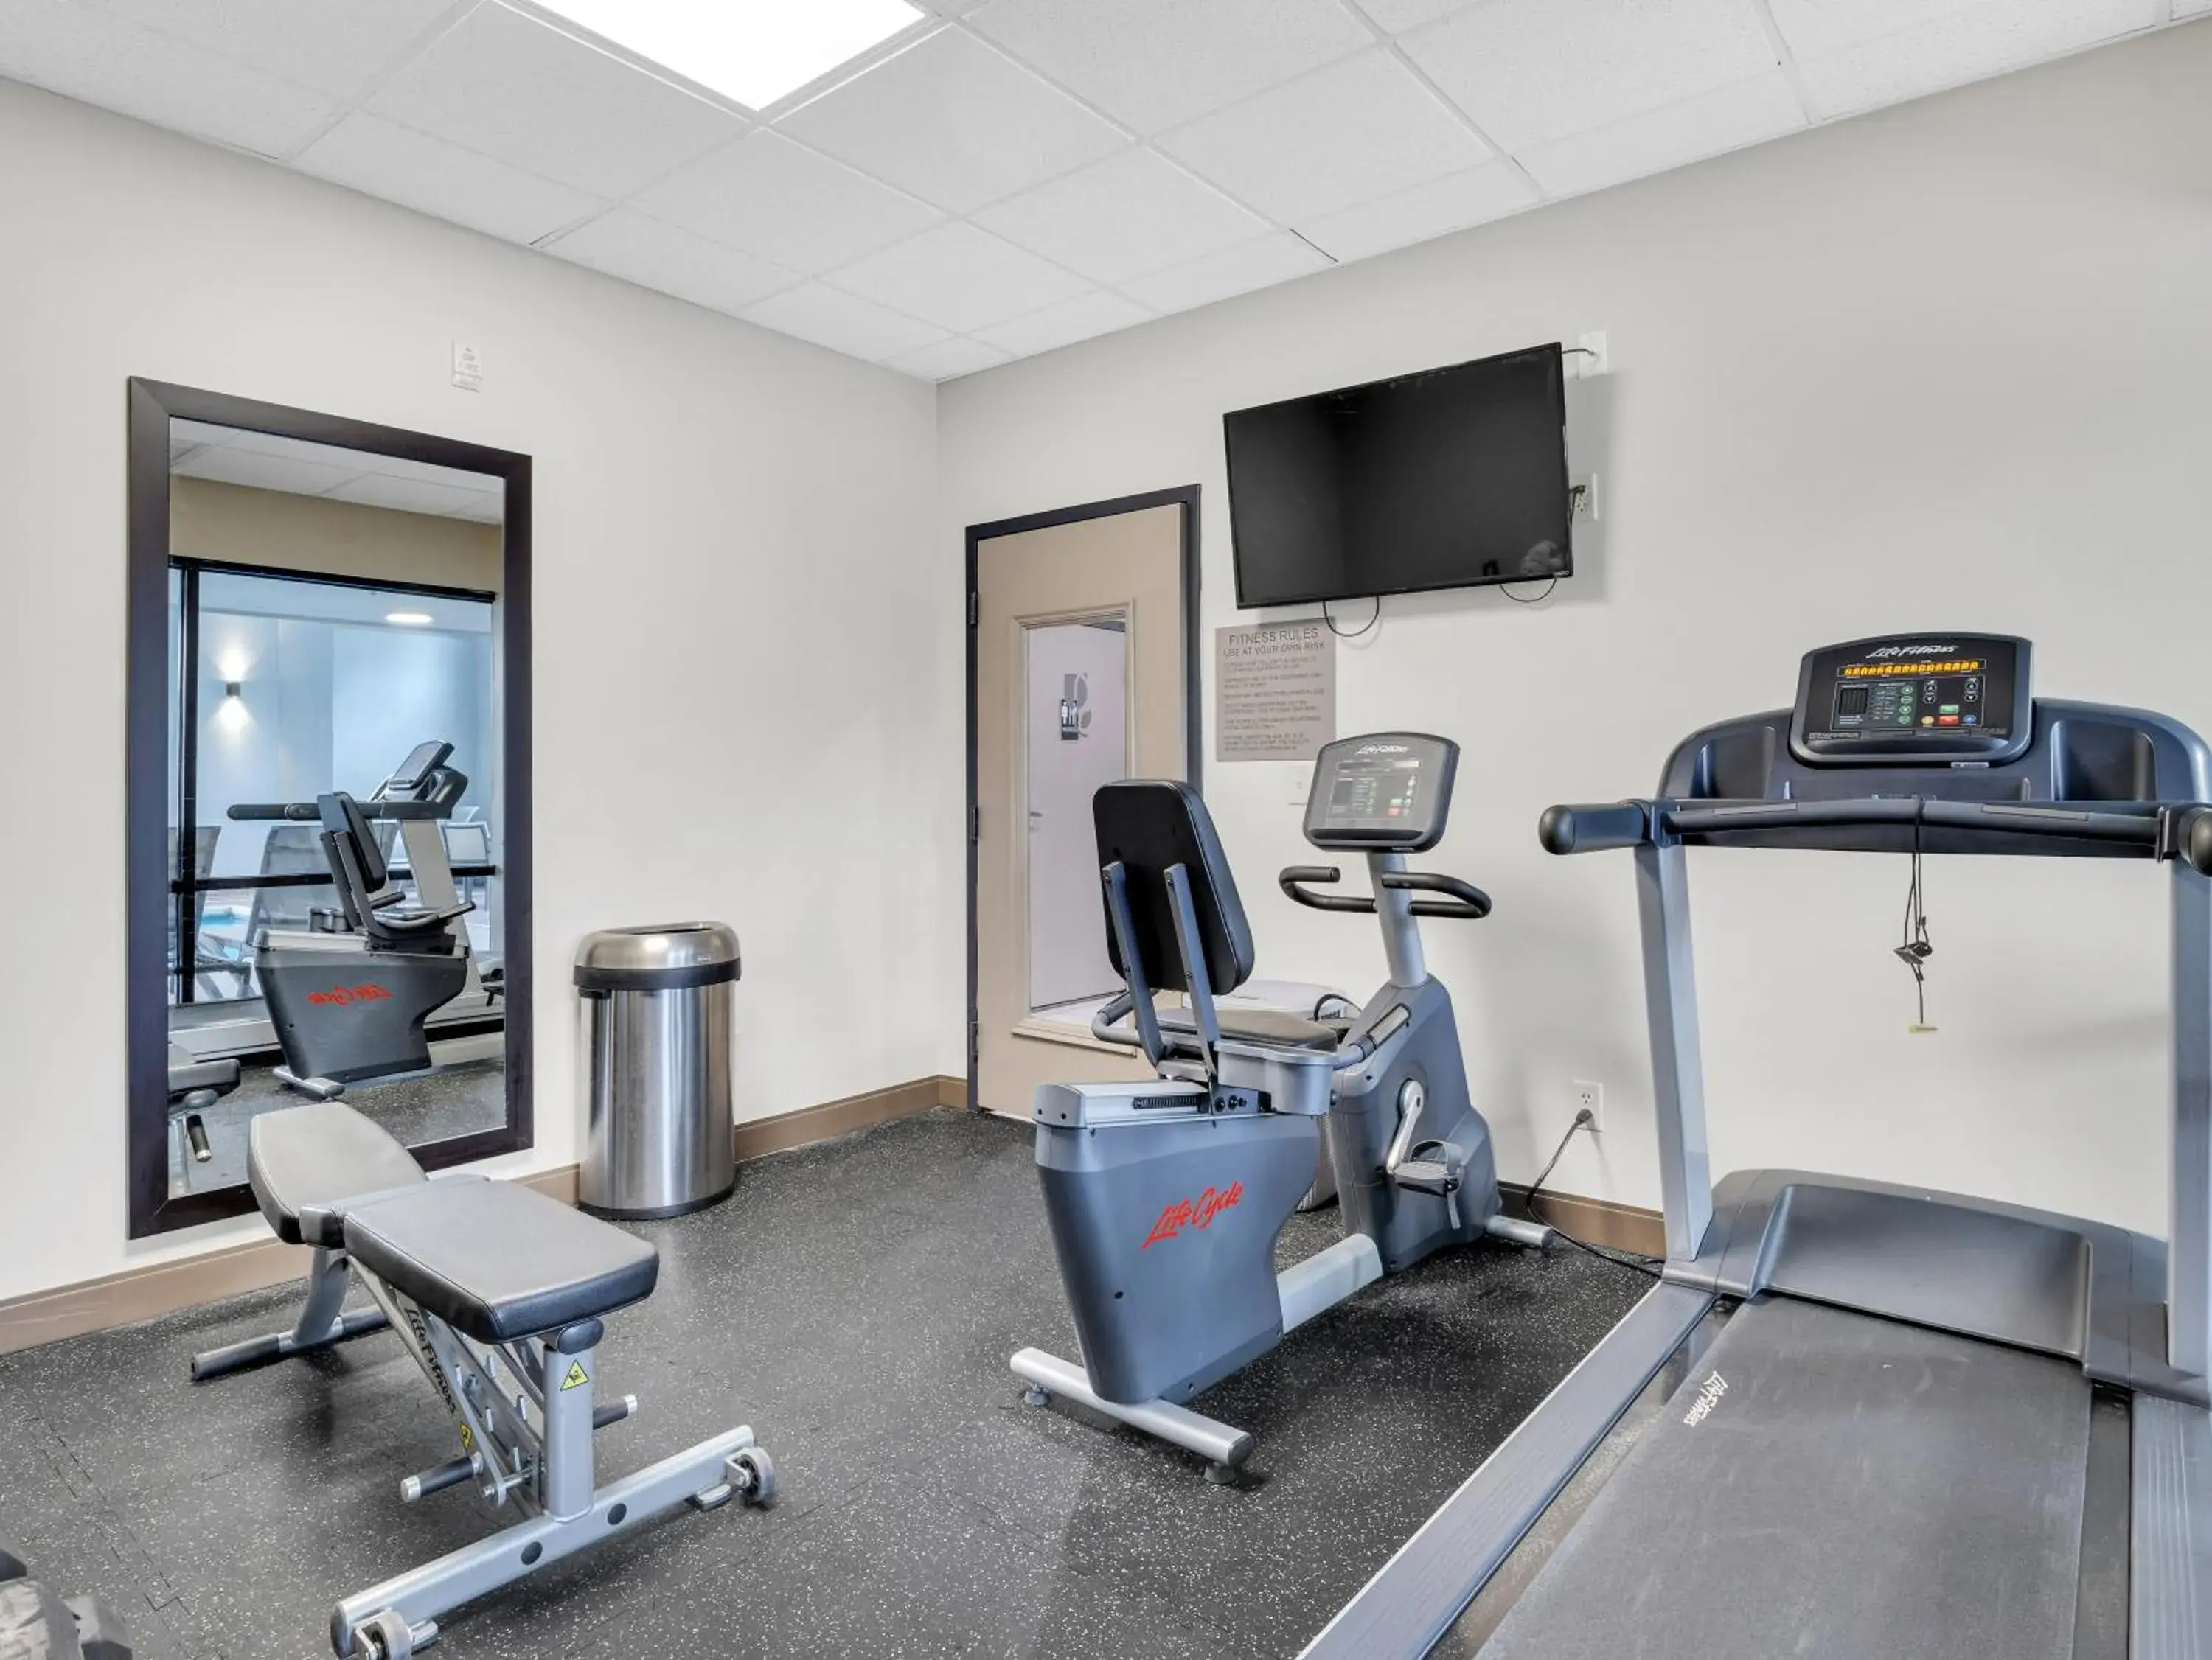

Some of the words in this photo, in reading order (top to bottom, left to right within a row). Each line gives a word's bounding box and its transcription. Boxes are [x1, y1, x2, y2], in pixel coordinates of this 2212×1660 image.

[1229, 632, 1276, 646] FITNESS
[1279, 627, 1319, 641] RULES
[1223, 648, 1239, 658] USE
[1242, 647, 1252, 655] AT
[1255, 645, 1279, 655] YOUR
[1281, 644, 1302, 653] OWN
[1304, 641, 1326, 651] RISK
[1141, 1197, 1192, 1250] Life
[1190, 1179, 1245, 1230] Cycle
